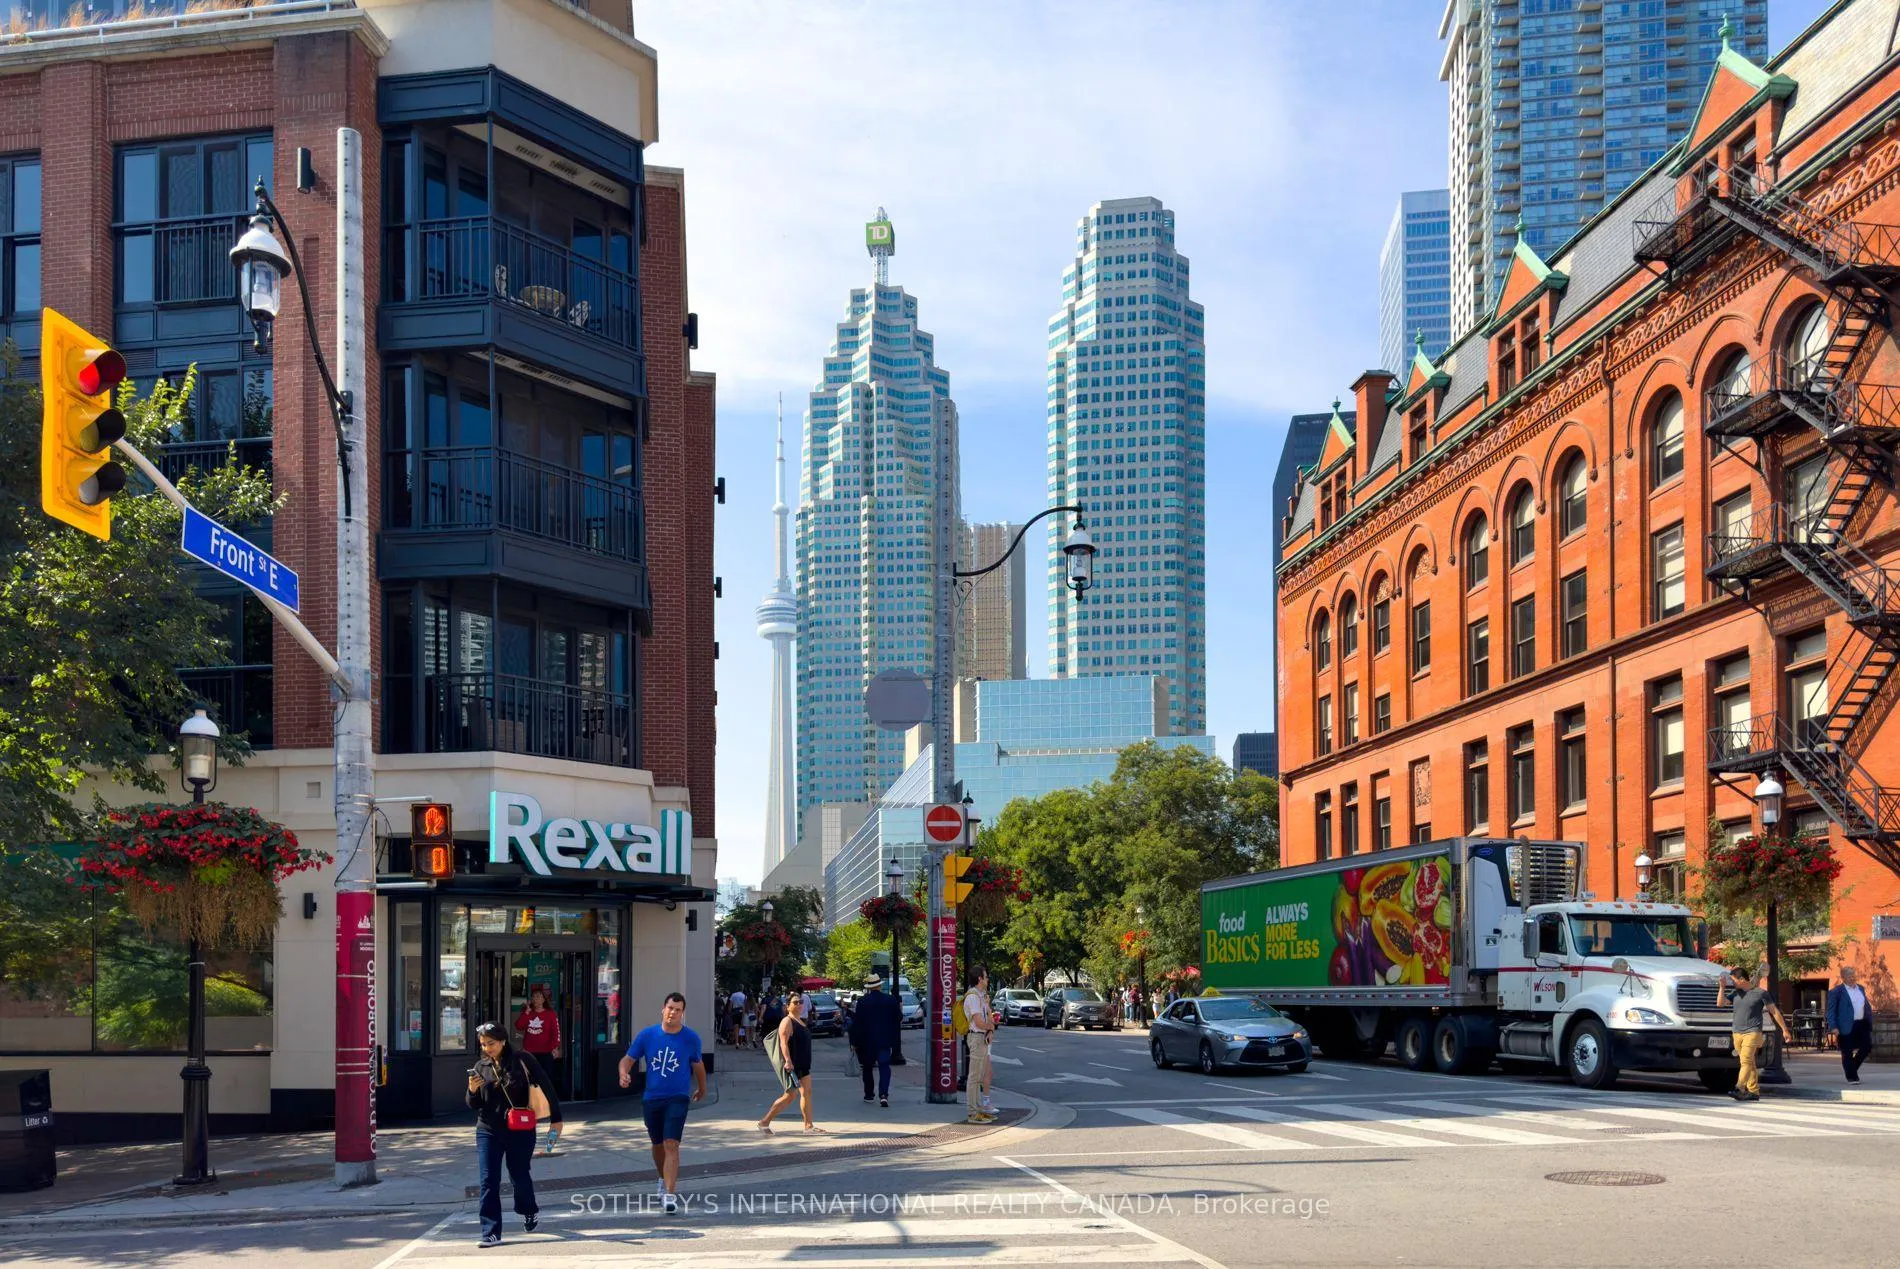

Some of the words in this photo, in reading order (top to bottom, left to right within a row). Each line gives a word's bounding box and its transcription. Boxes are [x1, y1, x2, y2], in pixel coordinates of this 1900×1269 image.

[868, 225, 889, 240] TD
[210, 526, 255, 577] Front
[258, 556, 267, 573] St
[269, 561, 279, 591] E
[489, 790, 693, 876] Rexall
[1219, 910, 1246, 933] food
[1265, 902, 1309, 924] ALWAYS
[1265, 922, 1298, 942] MORE
[1265, 942, 1287, 960] FOR
[1290, 939, 1320, 960] LESS
[941, 1057, 952, 1087] OLD
[25, 1117, 40, 1127] Litter
